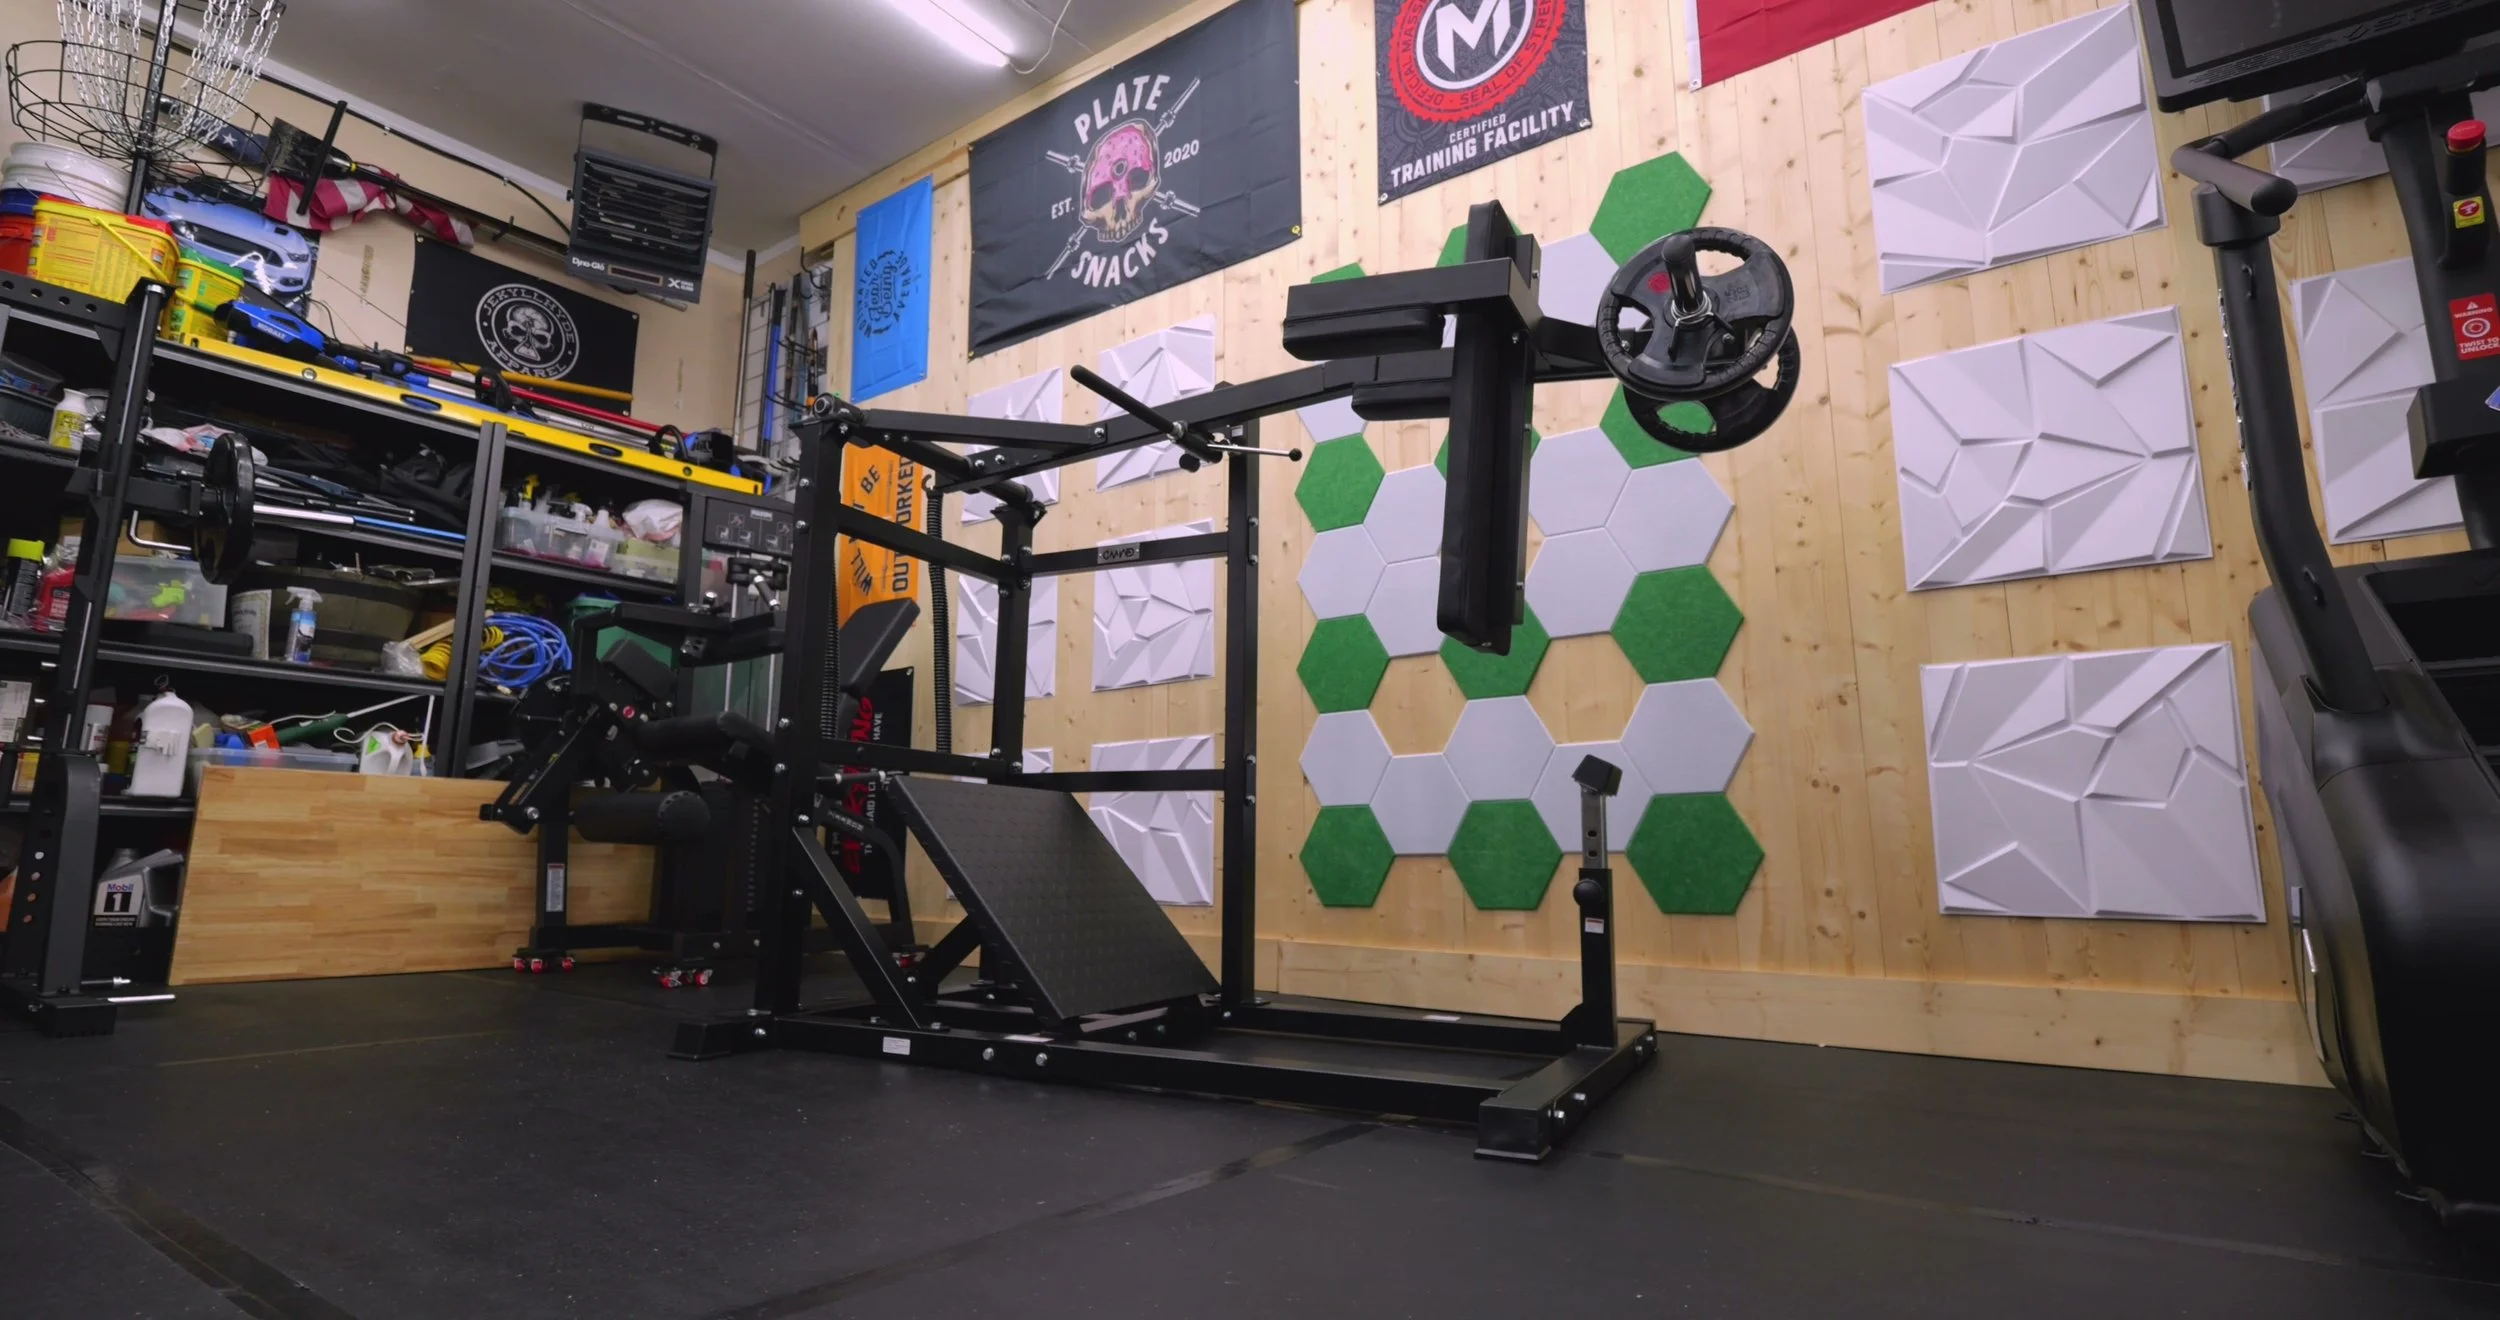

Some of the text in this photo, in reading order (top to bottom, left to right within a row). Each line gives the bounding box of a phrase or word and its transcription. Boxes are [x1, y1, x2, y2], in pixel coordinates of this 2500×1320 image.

[1402, 57, 1445, 106] OFFICIAL
[1460, 81, 1503, 106] SEAL
[1505, 59, 1525, 78] OF
[1074, 74, 1170, 144] PLATE
[1390, 100, 1574, 187] TRAINING FACILITY
[1449, 113, 1507, 144] CERTIFIED
[1163, 139, 1200, 169] 2020
[1051, 197, 1075, 220] EST.
[1071, 217, 1169, 288] SNACKS
[893, 250, 911, 323] AVERAGE
[2454, 307, 2493, 318] WARNING
[487, 339, 567, 377] APPAREL
[2459, 336, 2500, 349] TWIST TO
[2460, 343, 2500, 354] UNLOCK
[860, 464, 881, 495] BE
[851, 547, 873, 597] WILL
[873, 712, 883, 741] HAVE
[107, 883, 135, 892] Mobil
[112, 892, 123, 912] 1
